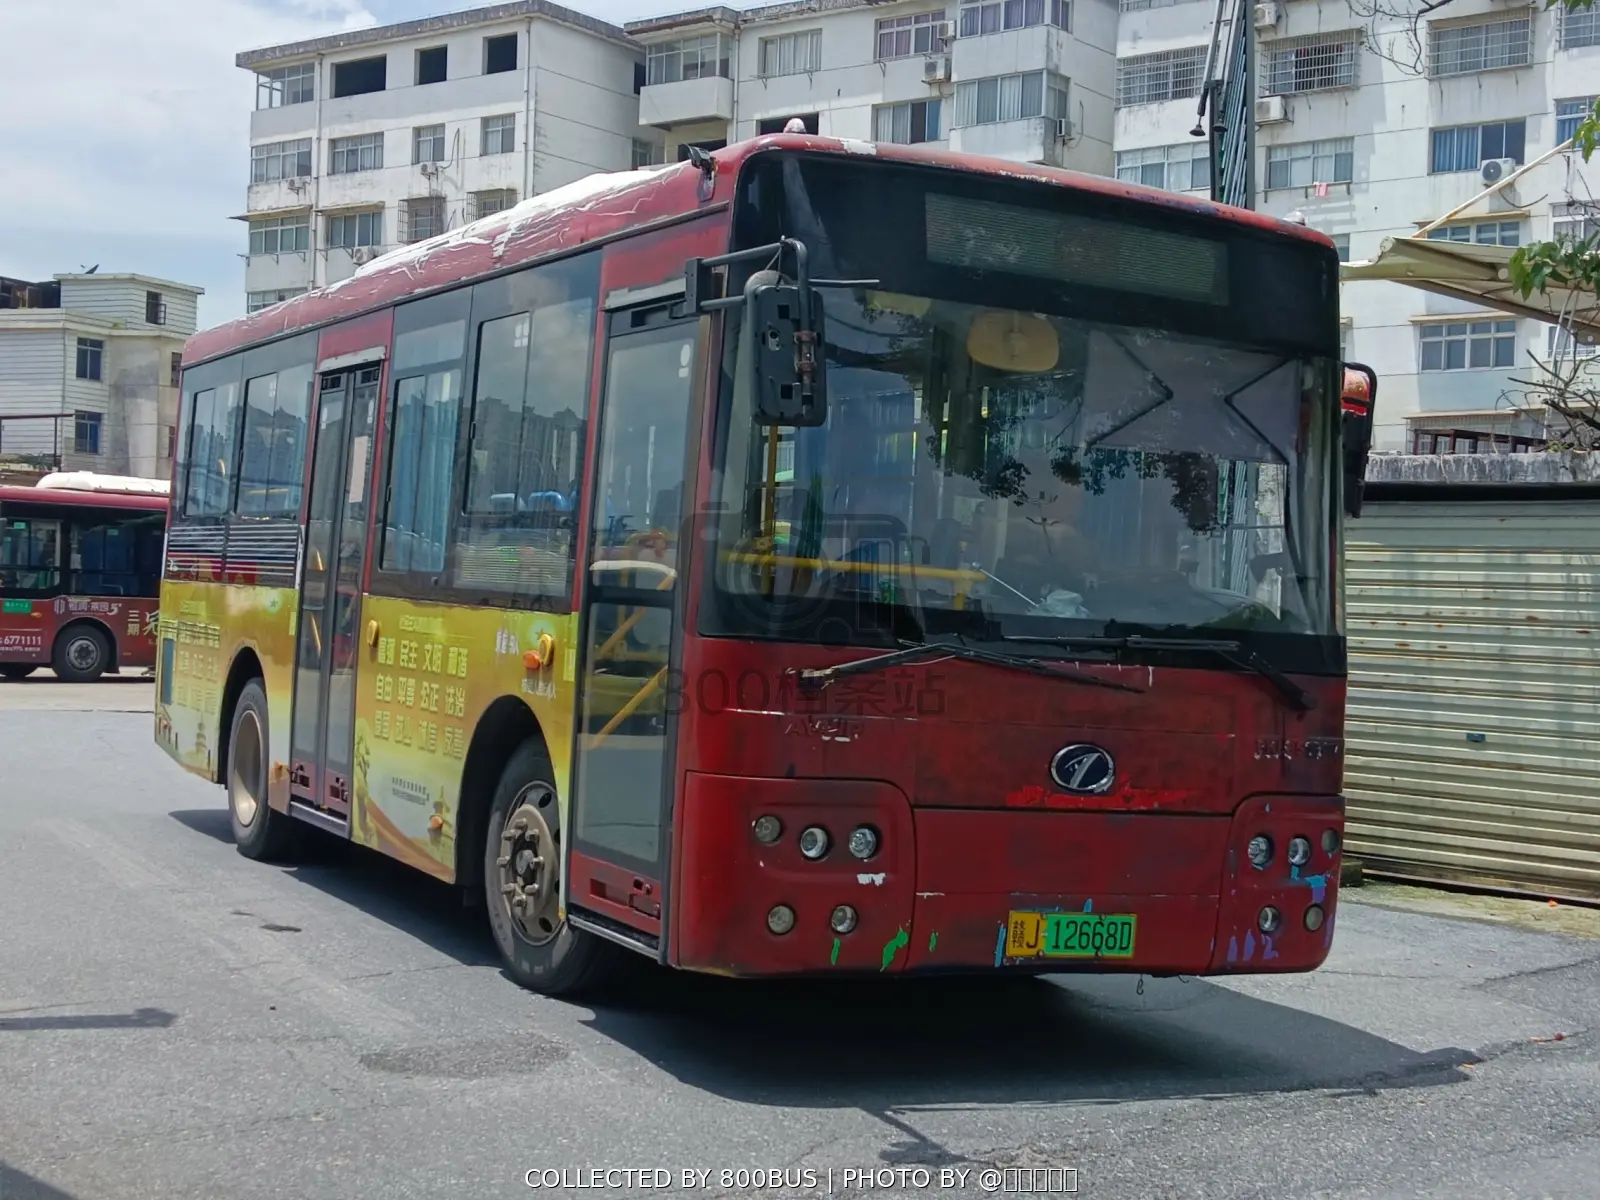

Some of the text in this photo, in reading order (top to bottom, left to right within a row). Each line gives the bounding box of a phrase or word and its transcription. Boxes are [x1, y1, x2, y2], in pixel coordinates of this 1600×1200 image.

[4, 635, 41, 645] 6771111
[400, 640, 418, 669] 民主
[376, 673, 393, 702] 自由
[421, 681, 440, 711] 公正
[445, 685, 466, 718] 法治
[1052, 920, 1132, 950] 12668D
